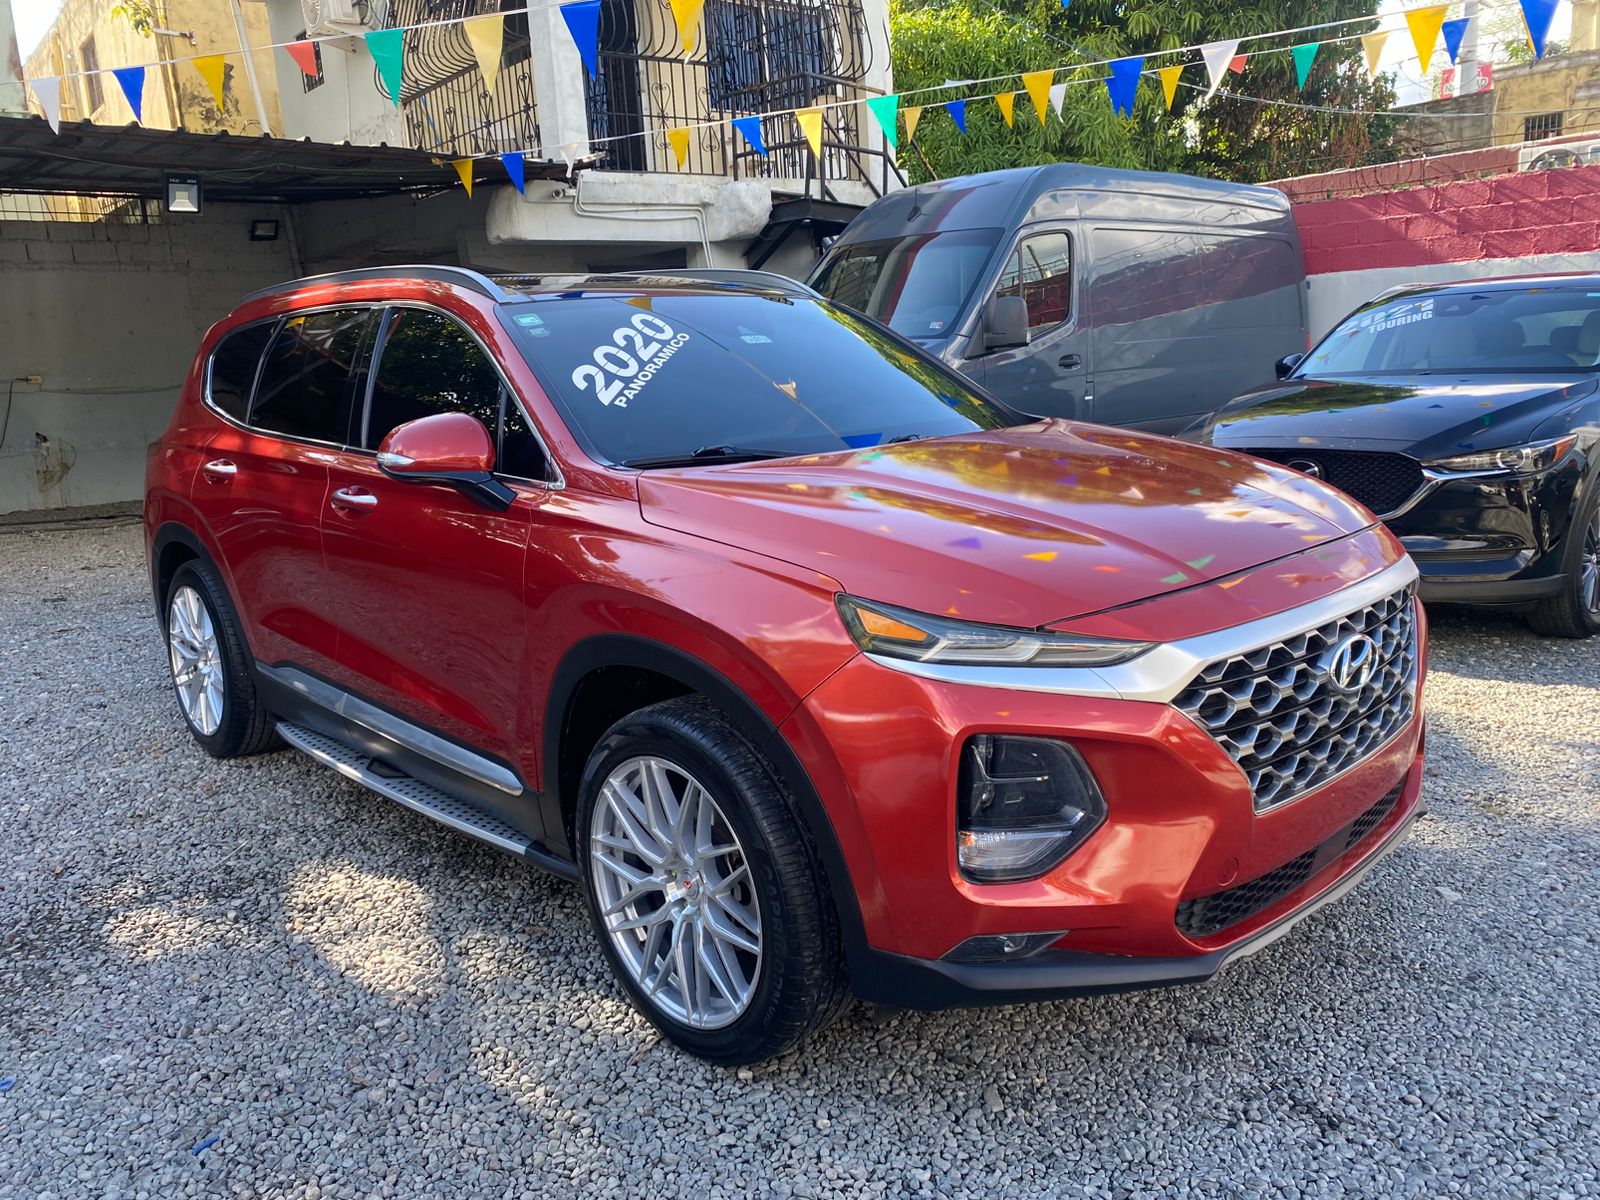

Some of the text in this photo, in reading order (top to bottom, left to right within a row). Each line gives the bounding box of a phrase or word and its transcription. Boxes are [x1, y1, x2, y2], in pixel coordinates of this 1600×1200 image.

[571, 313, 674, 406] 2020
[1368, 310, 1433, 334] TOURING
[613, 333, 690, 408] PANORAMICO
